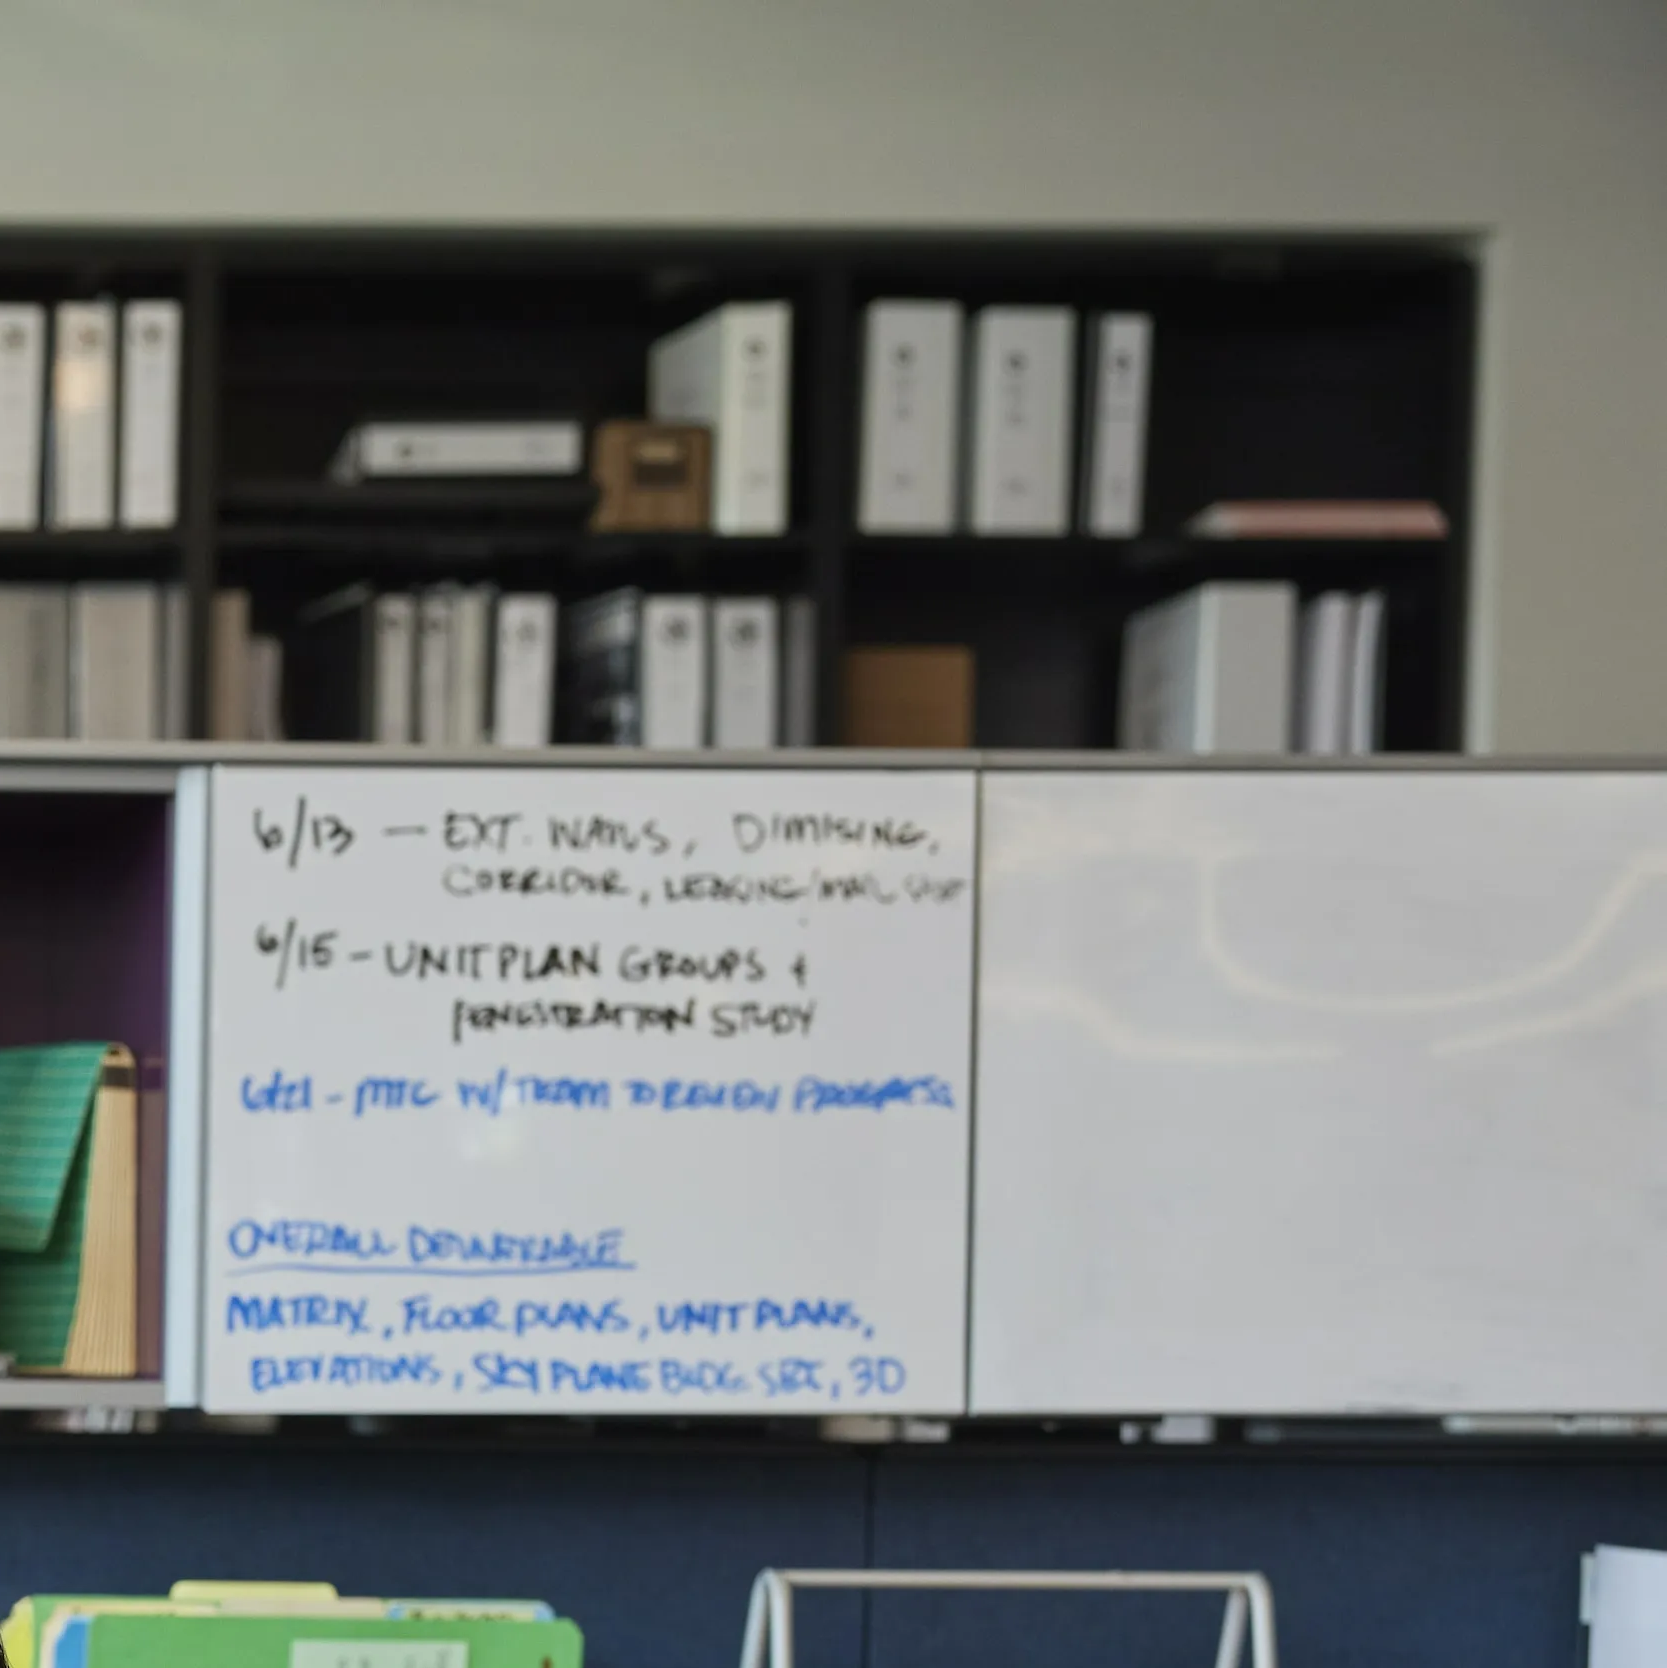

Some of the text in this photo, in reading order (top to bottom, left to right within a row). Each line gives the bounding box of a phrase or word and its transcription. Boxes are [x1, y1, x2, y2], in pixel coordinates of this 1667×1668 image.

[253, 795, 356, 870] 6/13
[442, 866, 651, 907] CORRIDOR,
[254, 917, 339, 991] 6/15
[383, 940, 491, 981] UNIT
[497, 942, 602, 981] PLAN
[618, 945, 767, 982] GROUPS
[710, 1001, 817, 1038] STUDY
[227, 1218, 398, 1260] OVERALL
[225, 1292, 394, 1340] MATRIX,
[402, 1294, 512, 1334] FLOOR
[655, 1300, 753, 1335] UNIT
[249, 1354, 464, 1394] ELEVATIONS,
[848, 1355, 907, 1395] 3D
